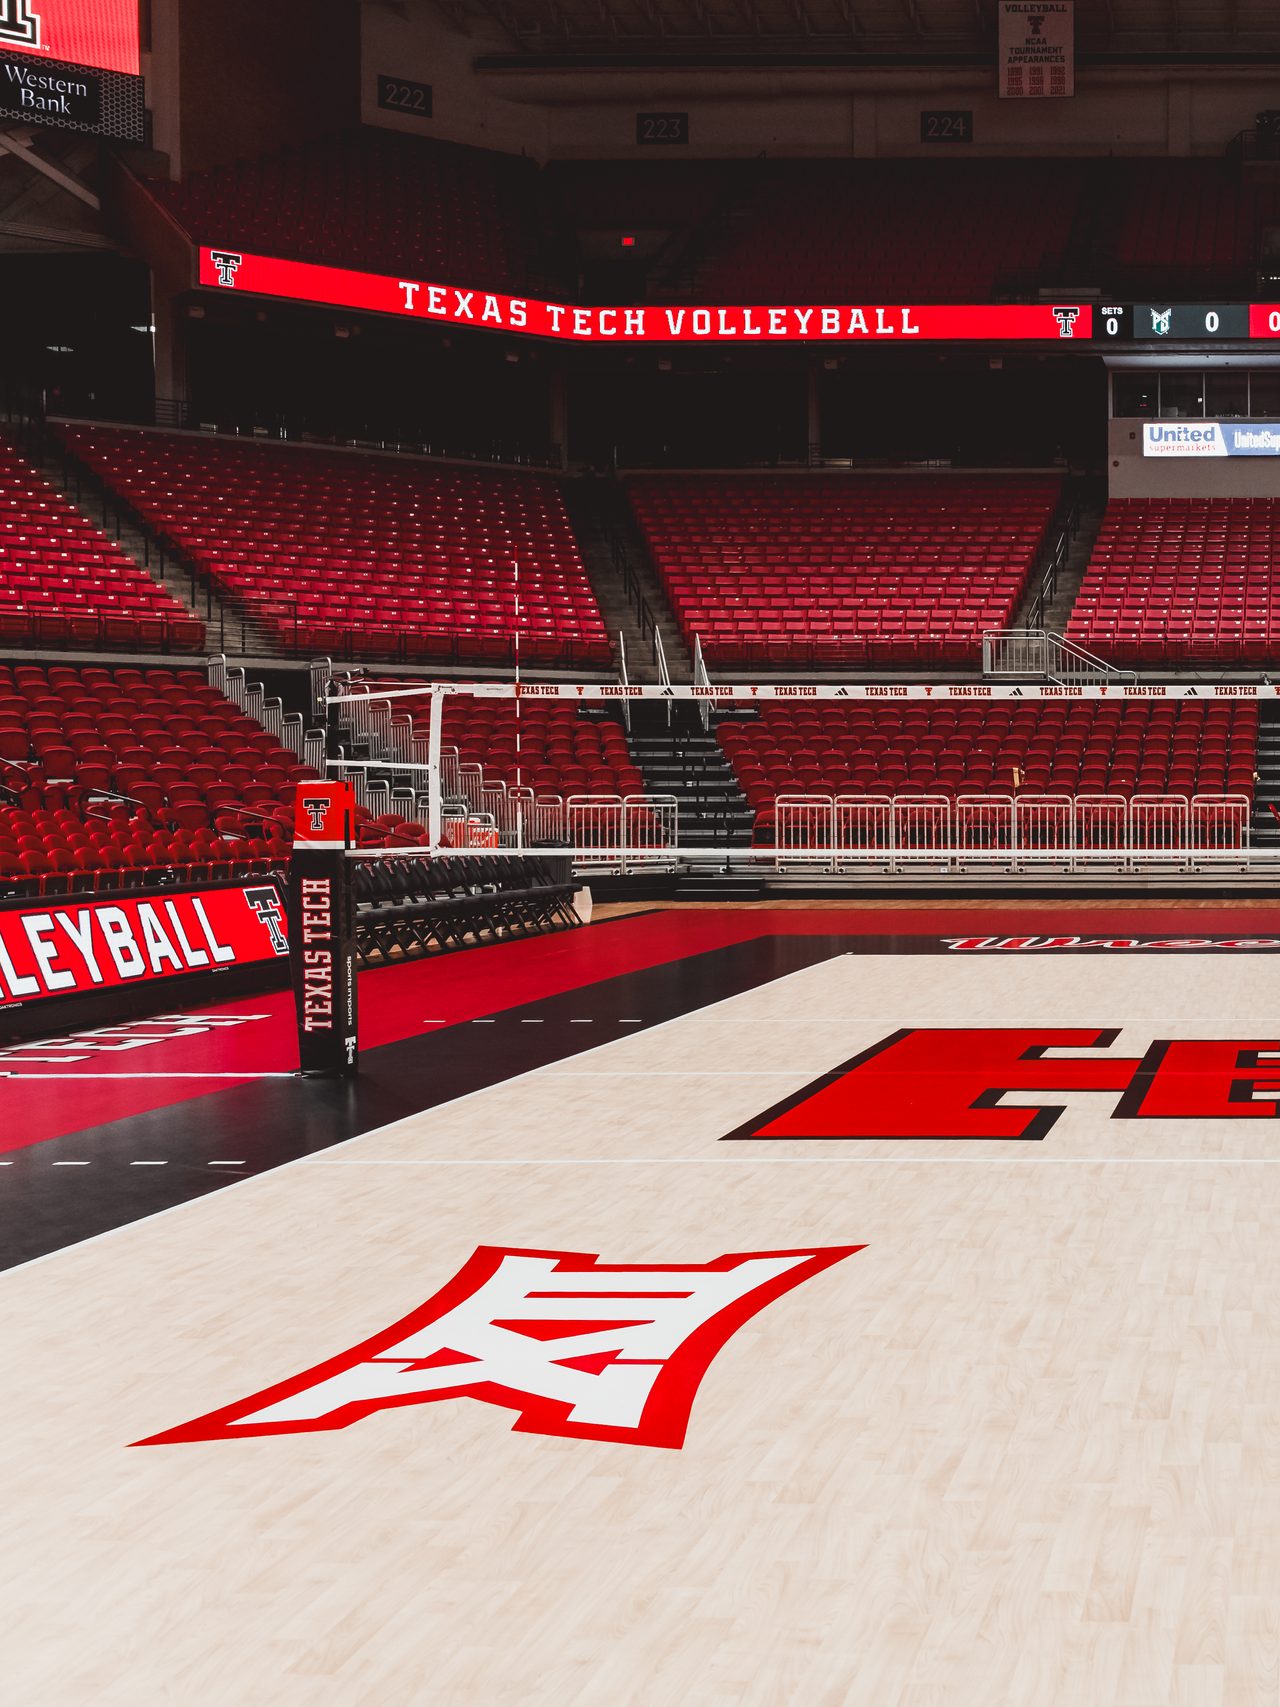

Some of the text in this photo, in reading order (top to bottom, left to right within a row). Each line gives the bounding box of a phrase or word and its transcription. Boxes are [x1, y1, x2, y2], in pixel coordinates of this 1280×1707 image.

[1005, 4, 1068, 13] VOLLEYBALL
[1009, 46, 1063, 55] TOURNAMENT
[1007, 55, 1066, 64] APPEARANCES
[4, 64, 88, 97] Western
[20, 87, 72, 115] Bank
[385, 83, 426, 111] 222
[643, 118, 681, 139] 223
[927, 116, 967, 138] 224
[398, 281, 921, 336] TEXAS TECH VOLLEYBALL
[1101, 307, 1124, 315] SETS
[1106, 318, 1119, 335] 0
[1205, 311, 1219, 332] 0
[1149, 426, 1216, 443] United
[1149, 443, 1216, 453] supermarkets
[541, 686, 559, 696] TECH
[600, 686, 642, 696] TEXAS TECH
[691, 686, 733, 696] TEXAS TECH
[774, 686, 816, 696] TEXAS TECH
[865, 686, 907, 696] TEXAS TECH
[949, 686, 991, 696] TEXAS TECH
[1040, 686, 1082, 696] TEXAS TECH
[1124, 686, 1166, 696] TEXAS TECH
[1215, 686, 1257, 696] TEXAS TECH
[0, 897, 236, 998] LEYBALL
[302, 878, 332, 1031] TEXAS TECH
